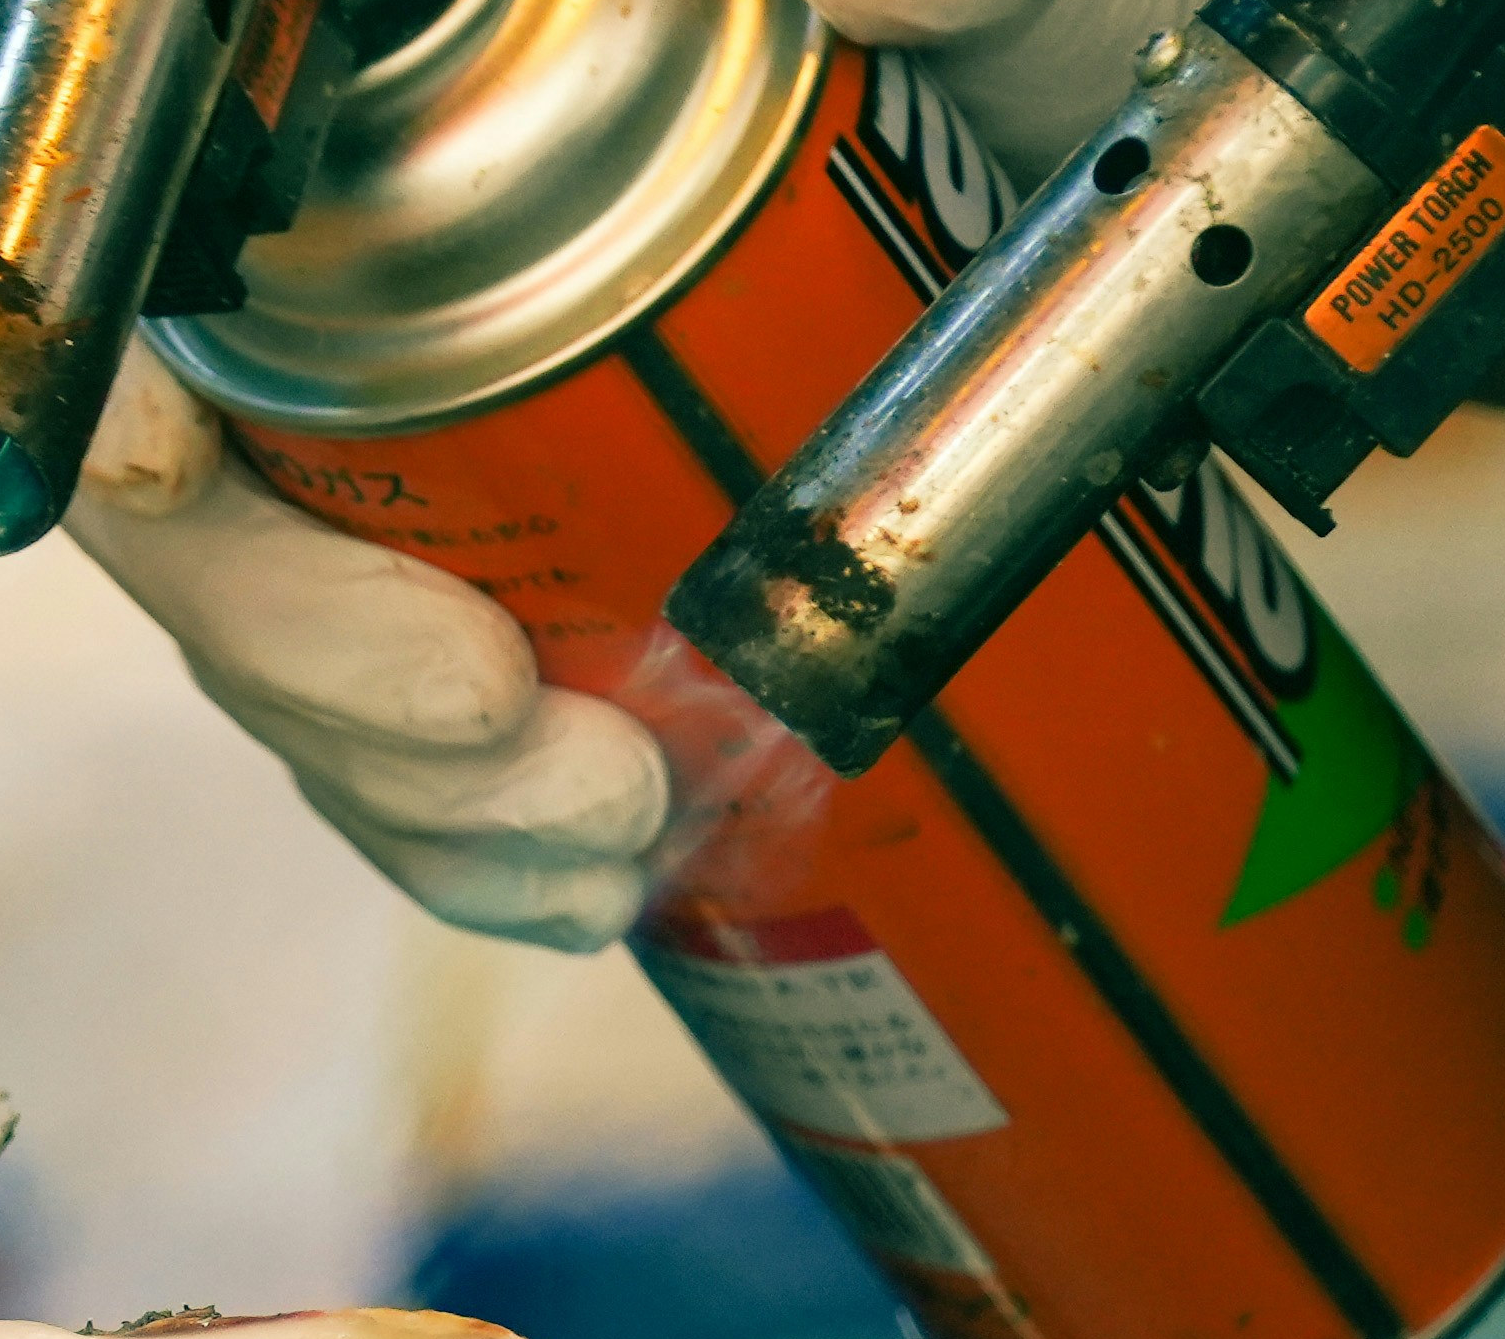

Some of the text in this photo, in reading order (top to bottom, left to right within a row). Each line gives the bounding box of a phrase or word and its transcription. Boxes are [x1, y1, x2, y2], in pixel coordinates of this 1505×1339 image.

[1329, 148, 1495, 324] POWER TORCH
[1377, 196, 1505, 331] HD-2500
